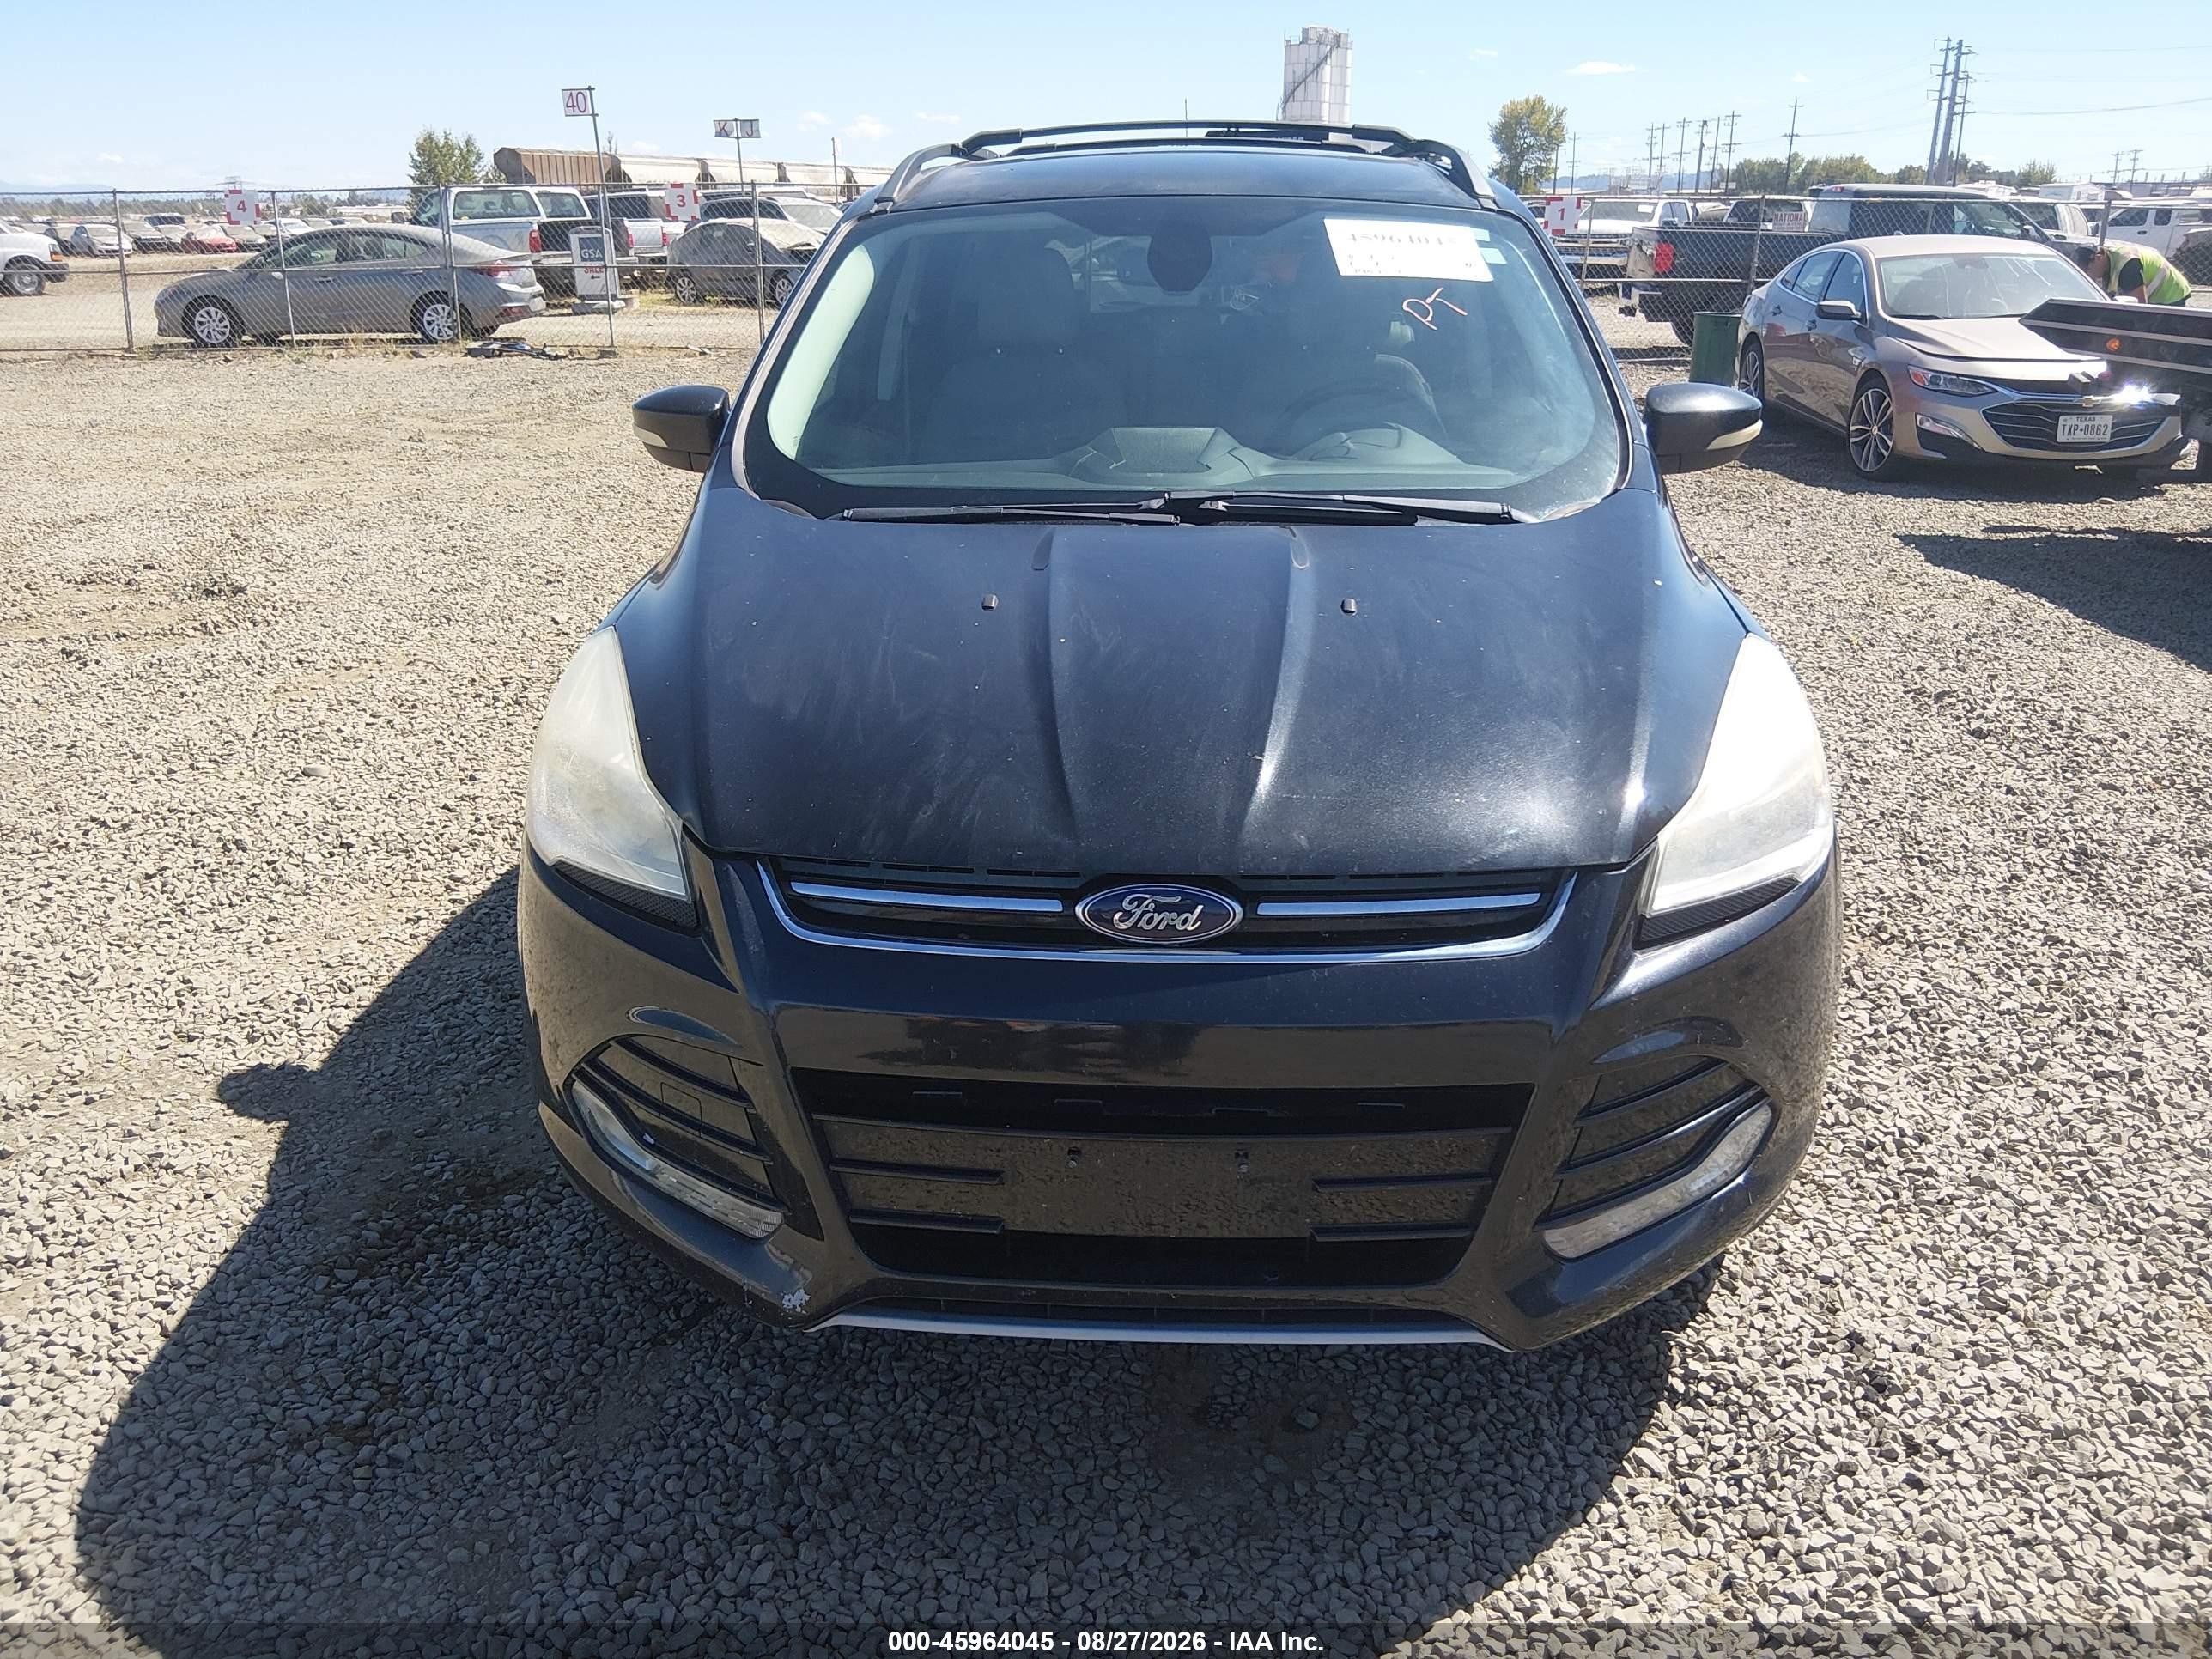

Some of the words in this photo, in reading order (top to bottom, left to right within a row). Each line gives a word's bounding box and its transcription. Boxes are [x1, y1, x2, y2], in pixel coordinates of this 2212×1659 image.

[565, 91, 587, 113] 40
[718, 122, 730, 137] K
[745, 120, 754, 137] J
[237, 199, 247, 213] 4
[676, 194, 686, 207] 3
[1558, 208, 1565, 221] 1
[581, 249, 603, 258] GSA
[1113, 893, 1204, 931] Ford
